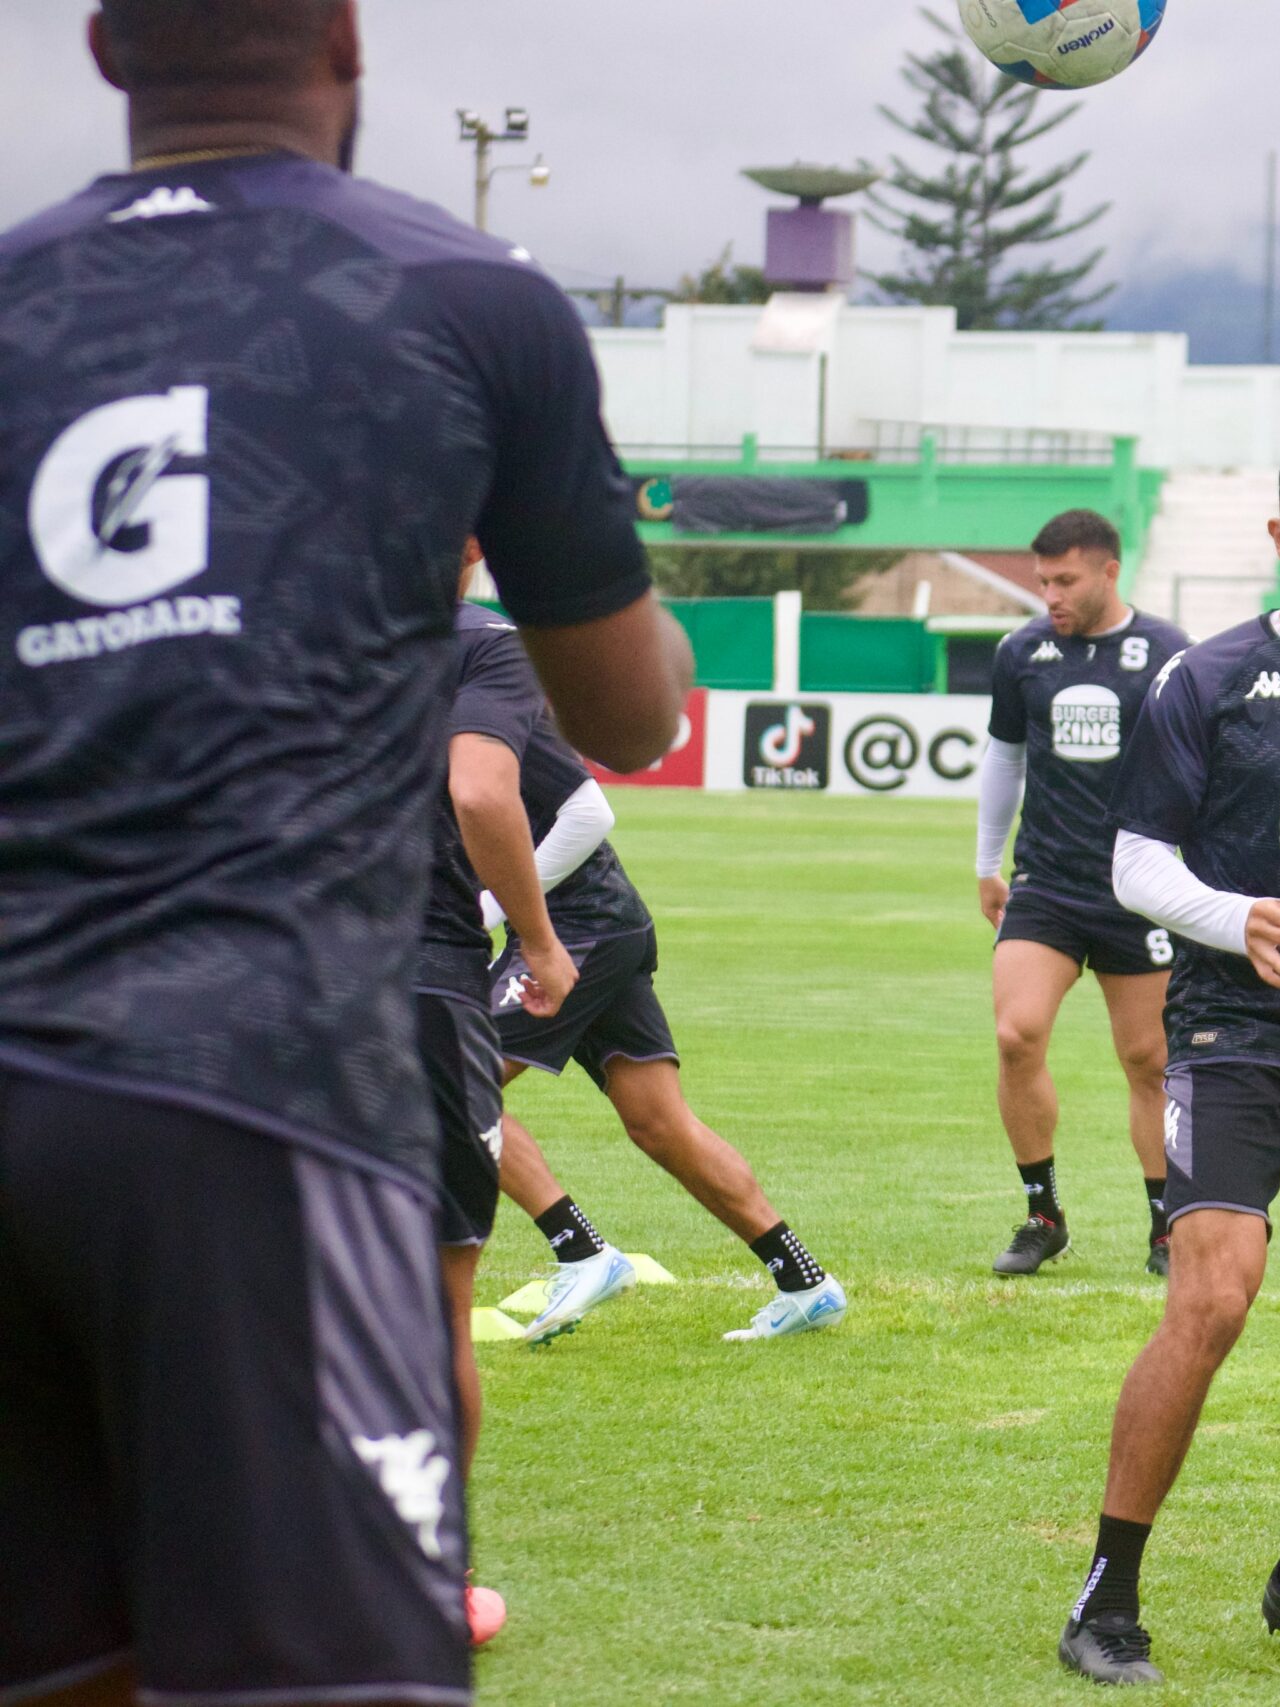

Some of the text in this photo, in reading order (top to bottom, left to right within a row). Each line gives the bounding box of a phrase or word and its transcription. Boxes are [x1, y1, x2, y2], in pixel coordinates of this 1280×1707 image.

[1057, 19, 1115, 55] molten
[28, 385, 209, 608] G
[17, 595, 242, 667] GATORADE
[1120, 636, 1149, 671] S
[1052, 705, 1120, 722] BURGER
[1054, 721, 1120, 745] KING
[754, 766, 819, 786] TikTok
[1146, 928, 1174, 965] S
